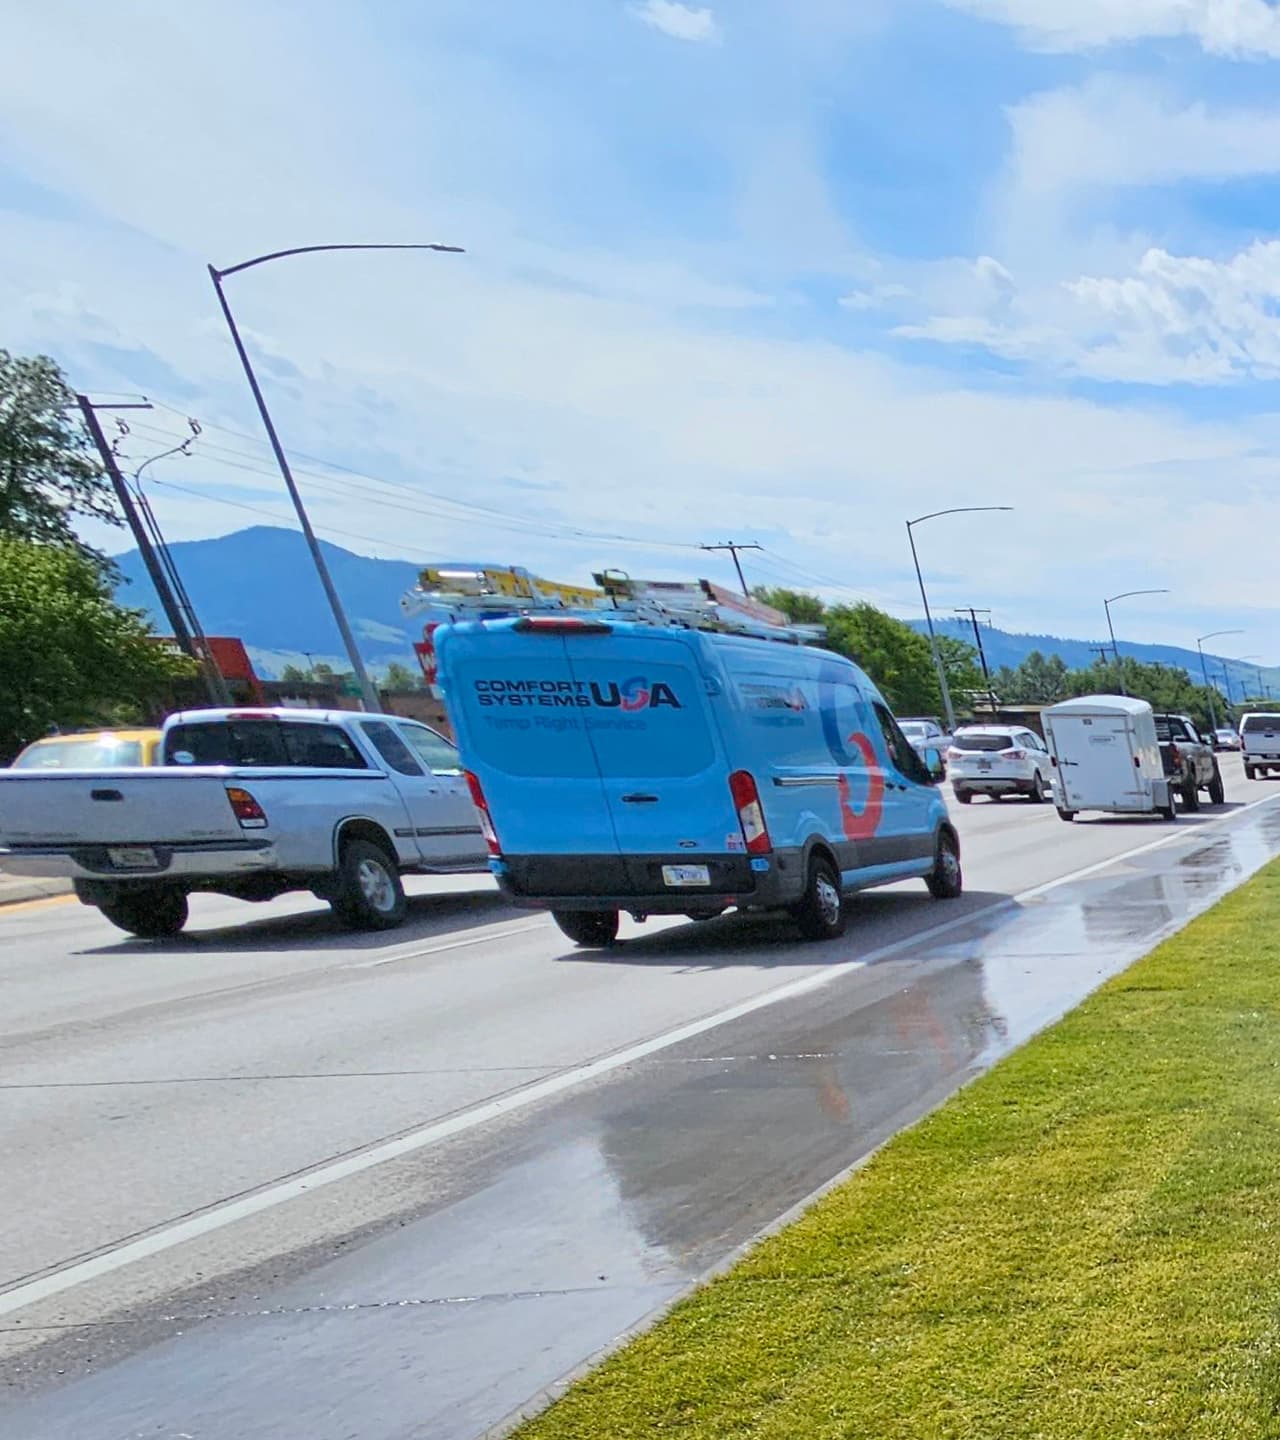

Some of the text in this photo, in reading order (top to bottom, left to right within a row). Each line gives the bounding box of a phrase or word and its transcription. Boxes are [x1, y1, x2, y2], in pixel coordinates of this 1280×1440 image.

[474, 676, 683, 711] COMFORT USA
[478, 694, 592, 708] SYSTEMS
